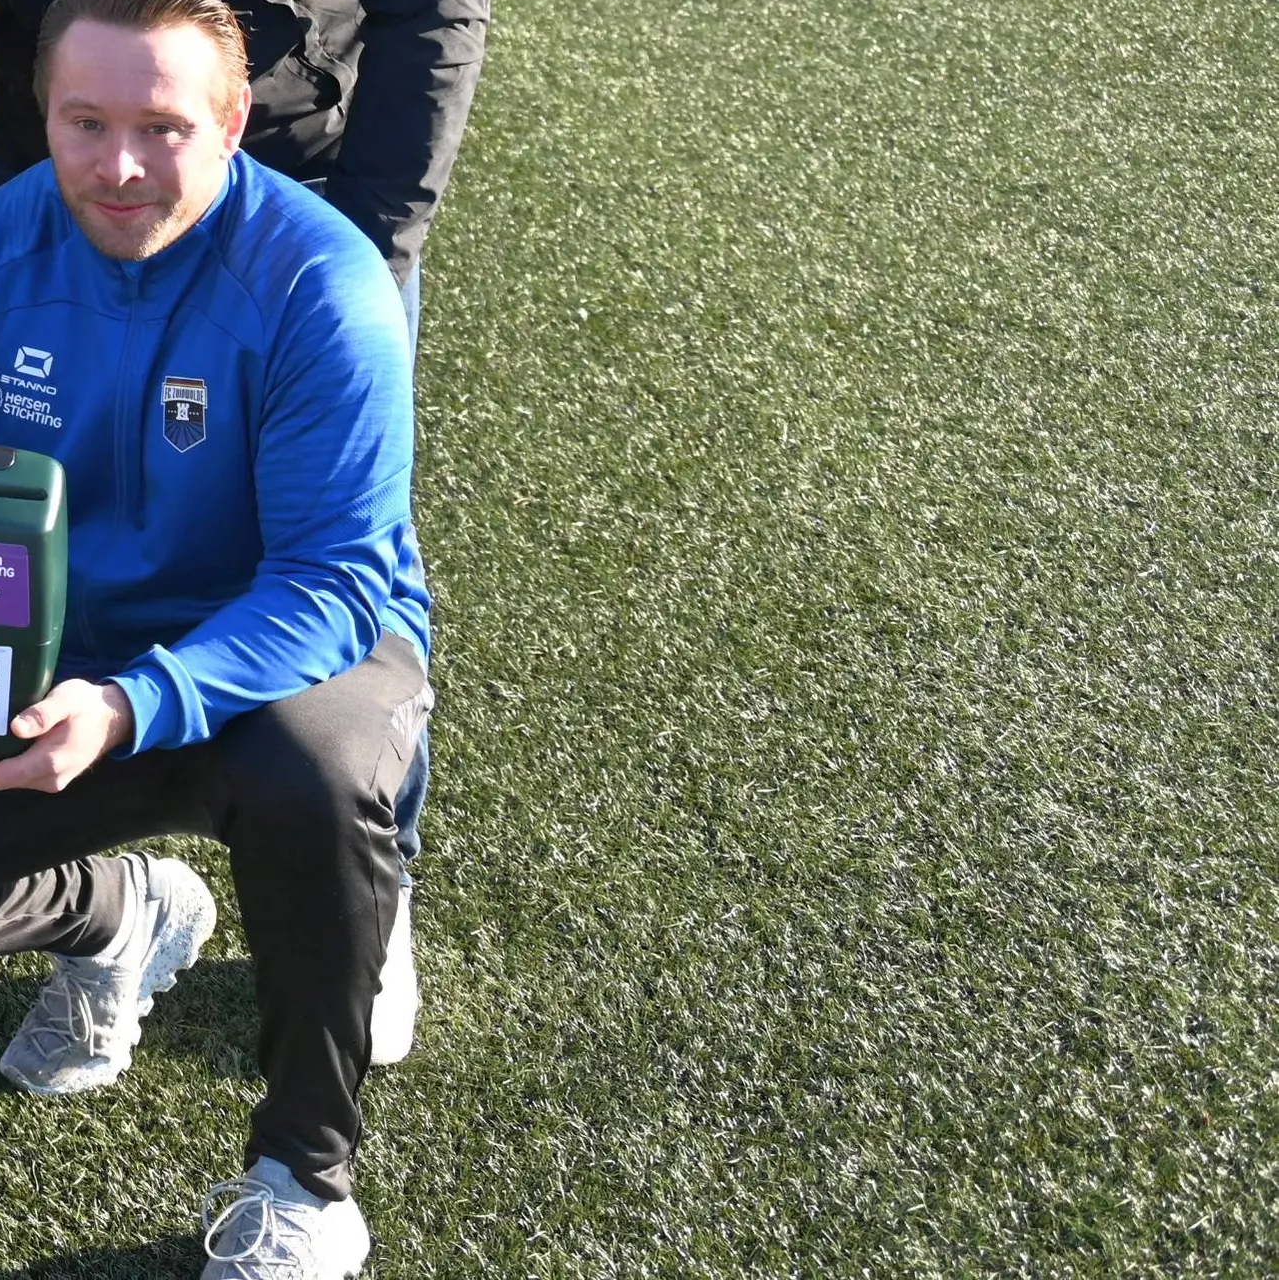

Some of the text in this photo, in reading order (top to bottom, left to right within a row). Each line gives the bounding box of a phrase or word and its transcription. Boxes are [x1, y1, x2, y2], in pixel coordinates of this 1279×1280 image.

[0, 374, 57, 396] STANNO
[5, 391, 51, 414] Hersen
[3, 403, 63, 428] STICHTING
